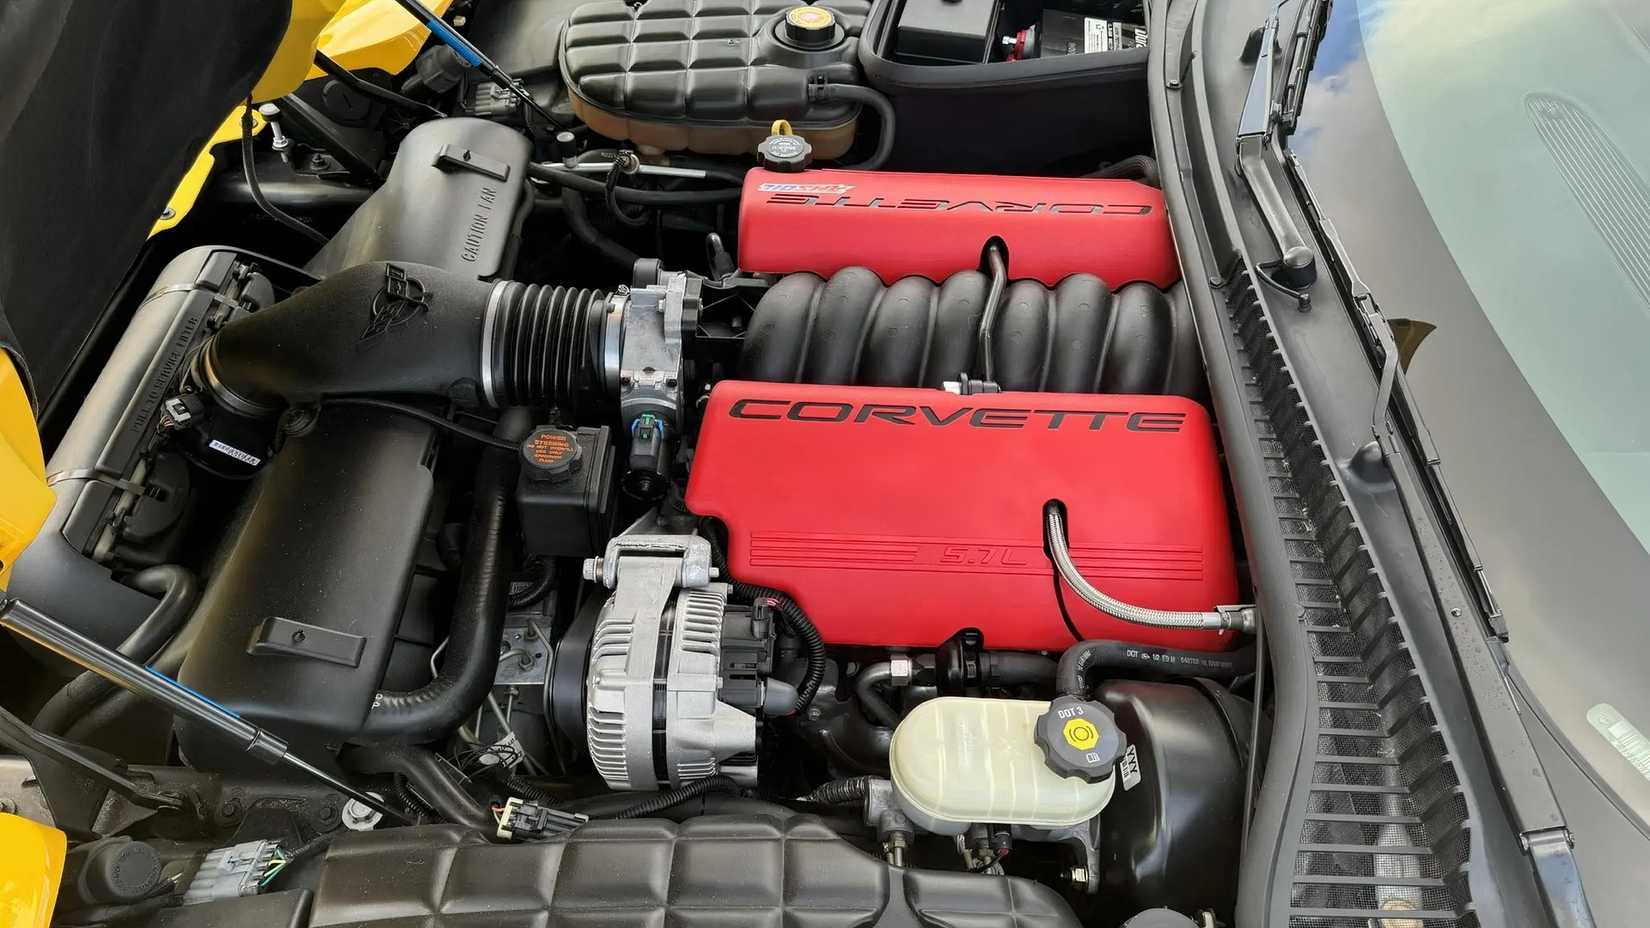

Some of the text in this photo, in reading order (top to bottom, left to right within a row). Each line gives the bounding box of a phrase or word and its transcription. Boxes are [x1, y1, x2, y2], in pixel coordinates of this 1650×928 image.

[766, 193, 1153, 216] CORVETTE
[461, 213, 489, 262] CAUTION
[728, 399, 1187, 432] CORVETTE
[940, 546, 1029, 567] 5.7L
[1058, 705, 1084, 719] DOT 3
